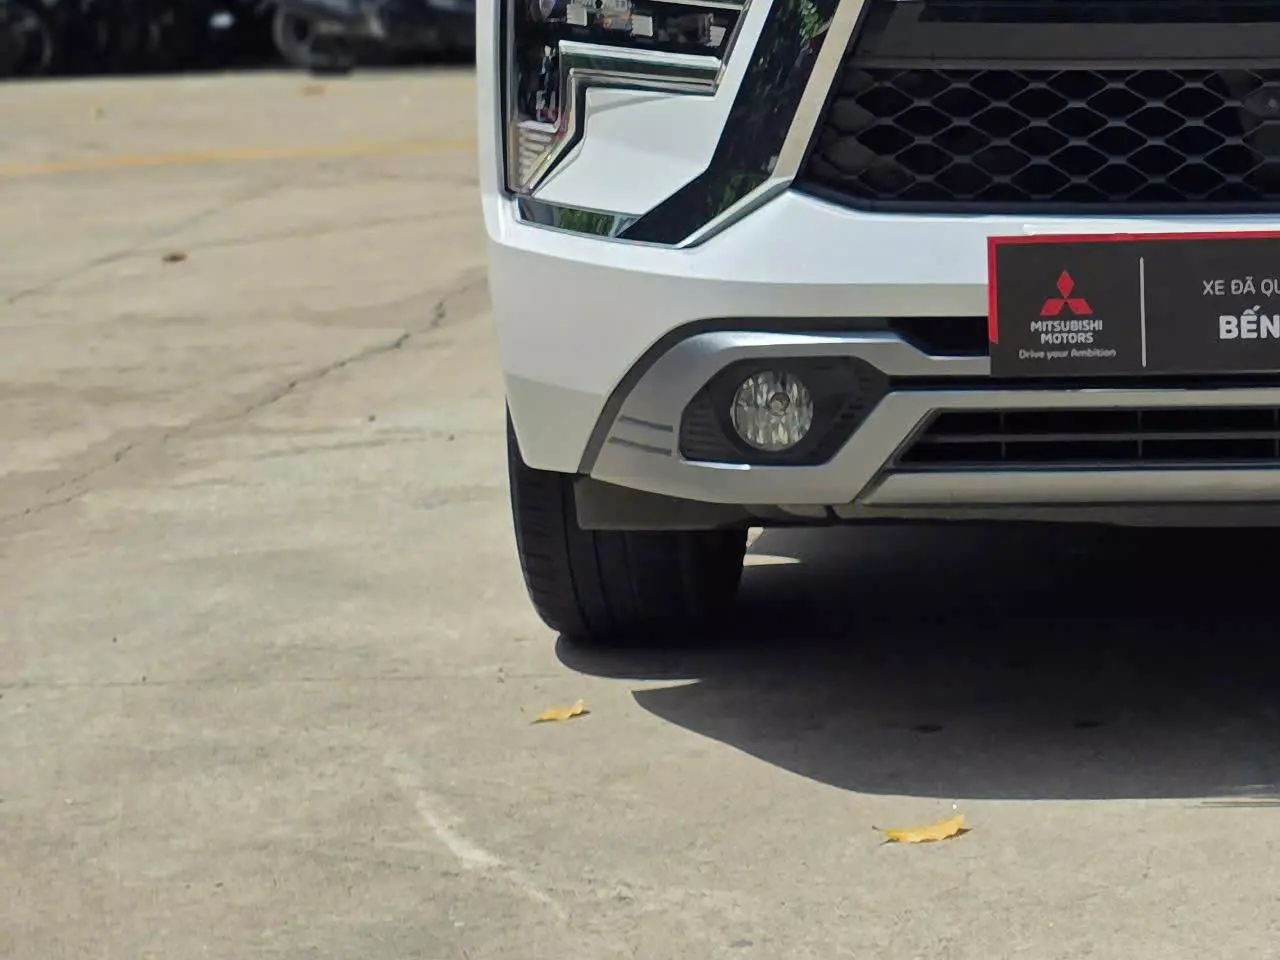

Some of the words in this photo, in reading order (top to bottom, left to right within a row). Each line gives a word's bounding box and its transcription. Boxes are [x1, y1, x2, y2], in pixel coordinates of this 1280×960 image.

[1202, 279, 1226, 296] XE
[1230, 276, 1256, 295] ĐÃ
[1030, 320, 1103, 332] MITSUBISHI
[1218, 305, 1280, 339] BẾN
[1040, 332, 1094, 345] MOTORS
[1018, 348, 1046, 359] Drive
[1046, 350, 1069, 360] your
[1070, 347, 1117, 358] Ambition
